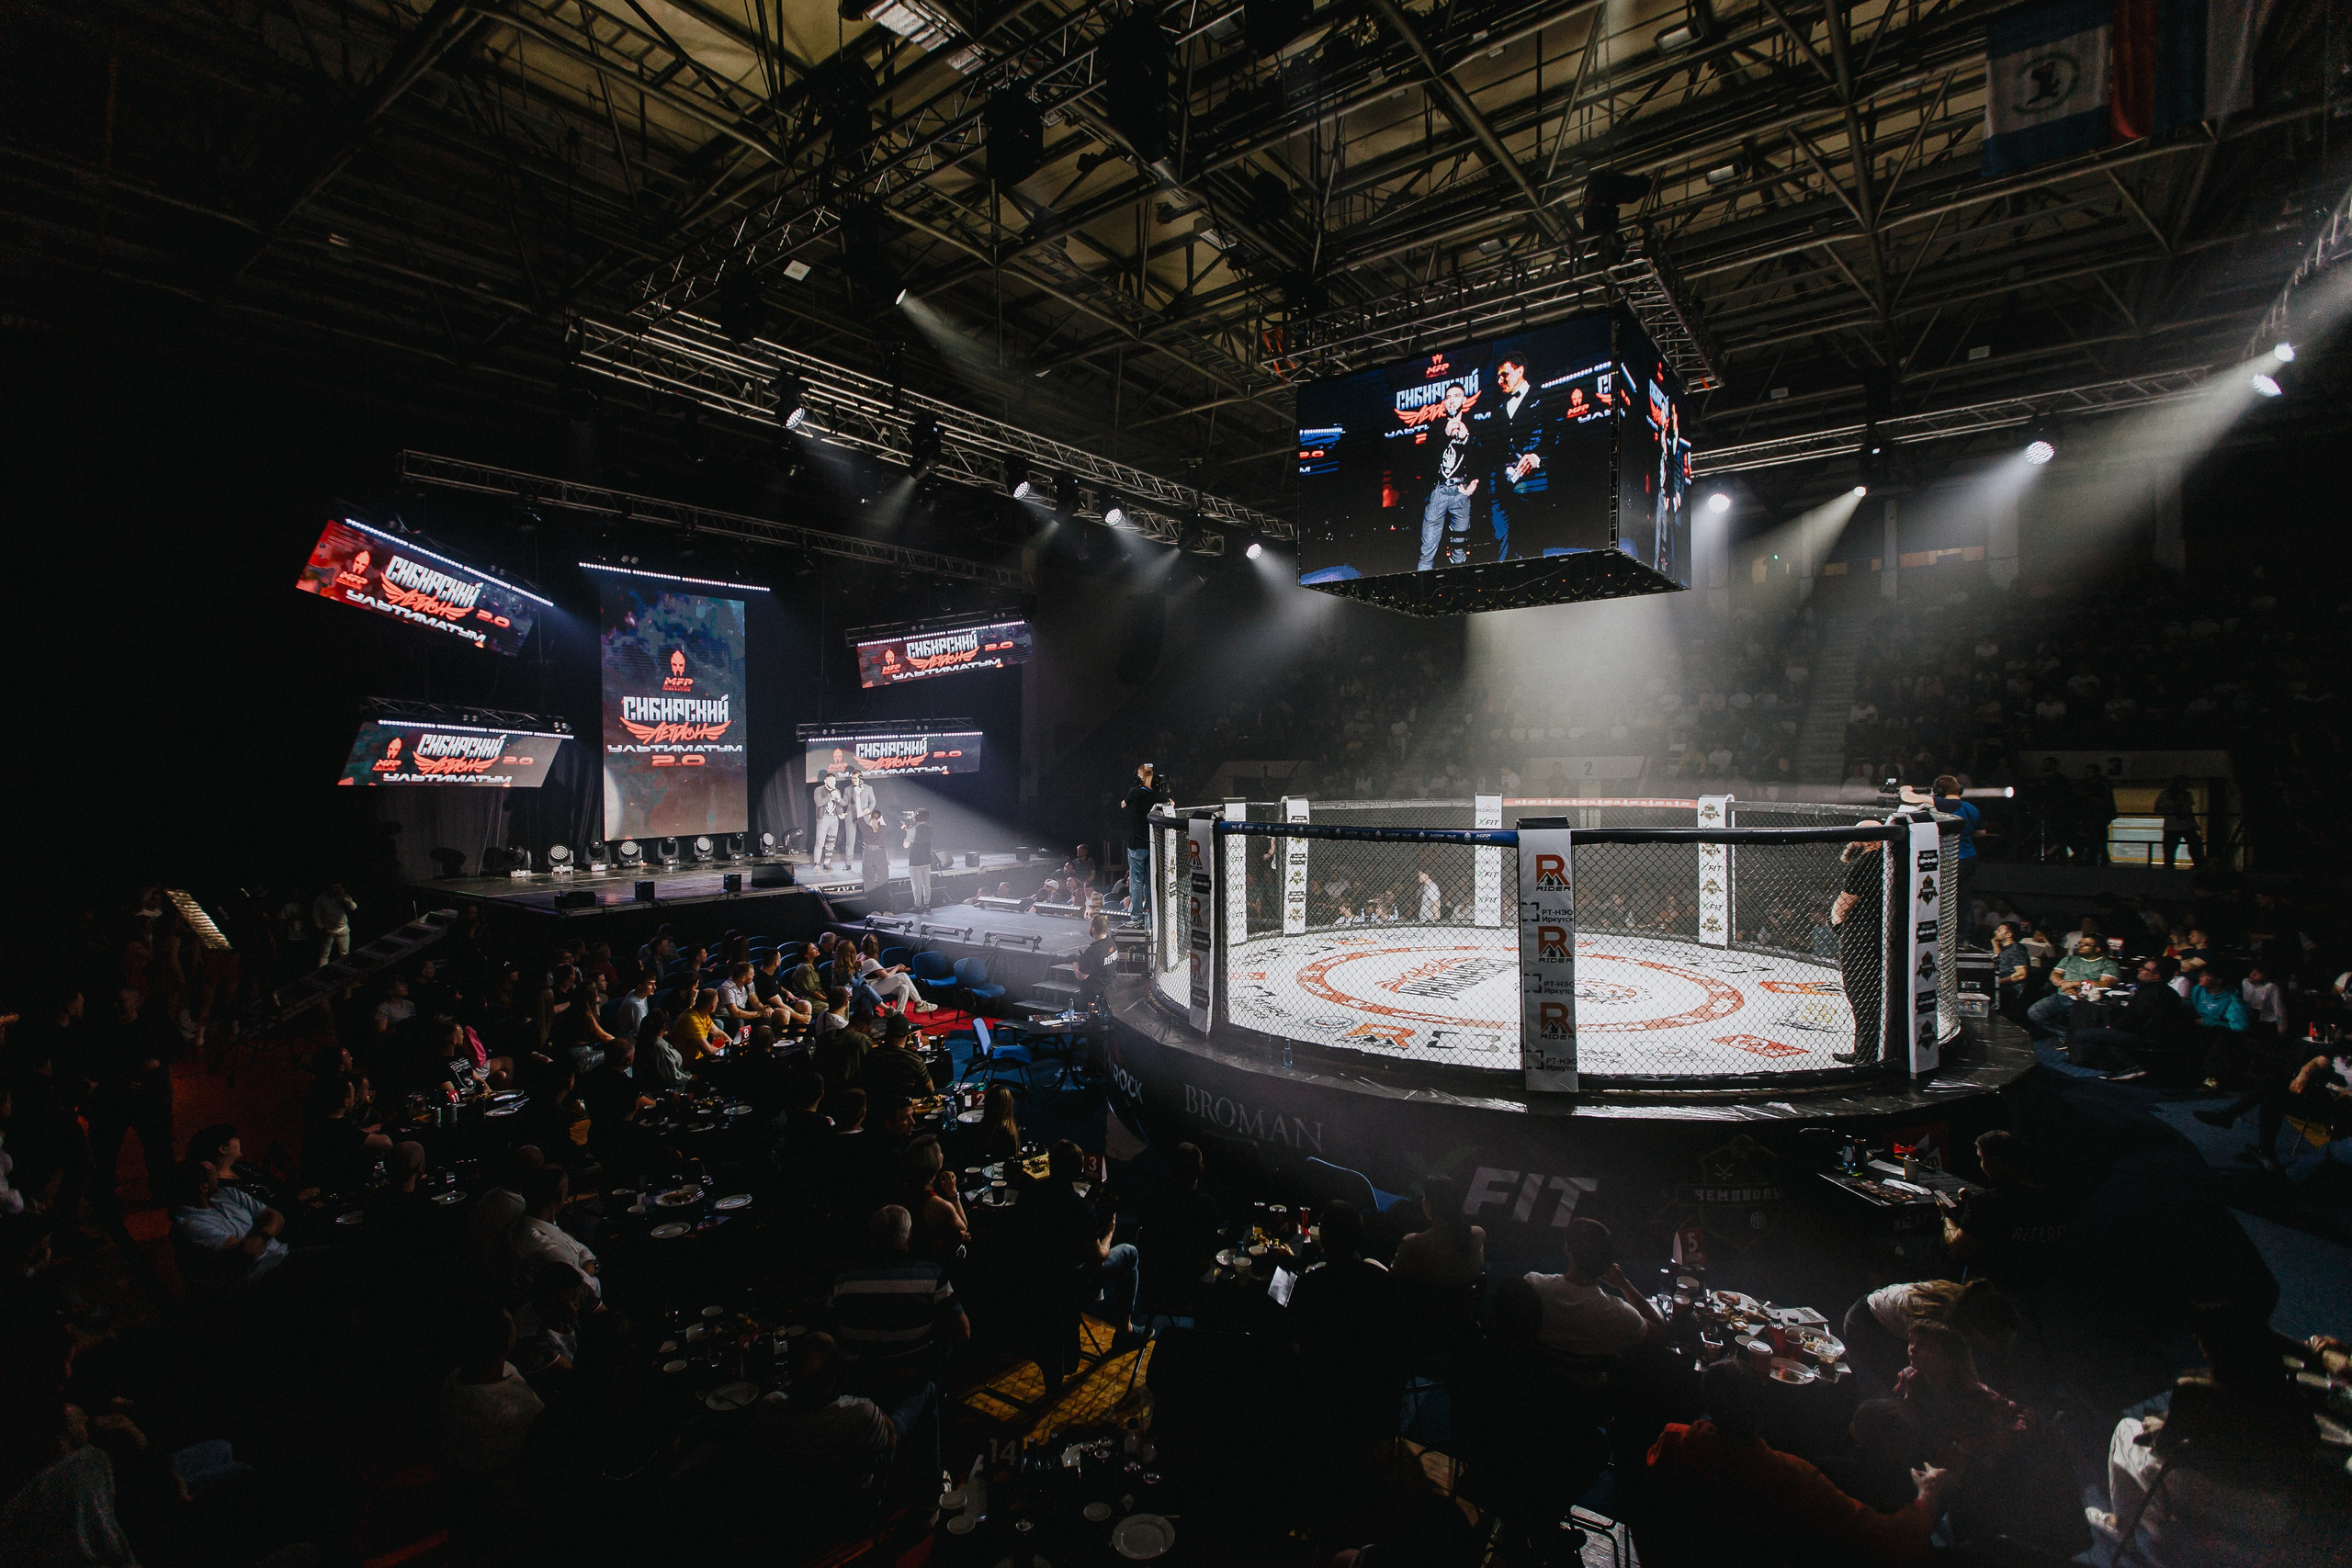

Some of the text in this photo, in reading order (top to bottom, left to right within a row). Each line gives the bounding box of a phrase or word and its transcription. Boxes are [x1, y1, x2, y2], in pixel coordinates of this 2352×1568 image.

[339, 570, 368, 585] MFP
[384, 555, 485, 608] СИБИРСКИЙ
[345, 589, 487, 644] УЛЬТИМАТУМ
[476, 608, 511, 628] 2.0
[905, 630, 978, 659] СИБИРСКИЙ
[984, 640, 1014, 652] 2.0
[881, 663, 901, 671] MFP
[892, 658, 1001, 681] УЛЬТИМАТУМ
[663, 676, 695, 686] MFP
[623, 694, 729, 723] СИБИРСКИЙ
[417, 733, 507, 759] СИБИРСКИЙ
[607, 744, 743, 753] УЛЬТИМАТУМ
[855, 737, 928, 759] СИБИРСКИЙ
[502, 756, 535, 765] 2.0
[651, 754, 706, 767] 2.0
[933, 750, 963, 759] 2.0
[375, 759, 402, 767] MFP
[1584, 761, 1593, 775] 2
[2108, 757, 2122, 776] 3
[382, 773, 513, 784] УЛЬТИМАТУМ
[743, 1028, 750, 1039] 8
[451, 1093, 459, 1103] 11
[976, 1093, 986, 1106] 2
[1184, 1083, 1324, 1154] BROMAN
[1088, 1156, 1097, 1171] 3
[1687, 1232, 1698, 1253] 5
[989, 1437, 1017, 1466] 14
